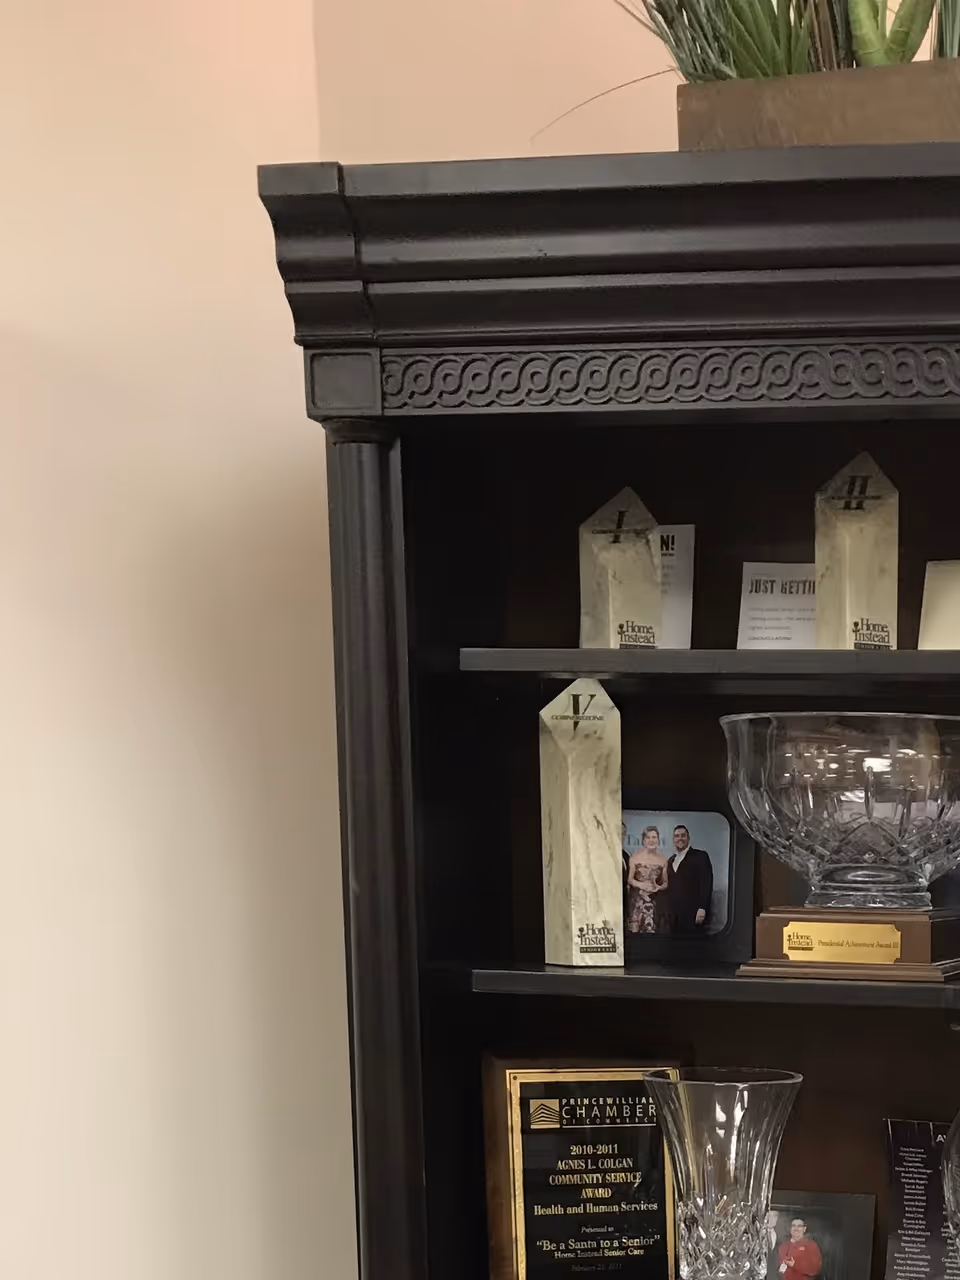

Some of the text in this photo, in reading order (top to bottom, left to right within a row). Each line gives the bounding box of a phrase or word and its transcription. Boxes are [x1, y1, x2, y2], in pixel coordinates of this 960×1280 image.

[839, 475, 873, 510] II
[749, 578, 776, 594] JUST
[626, 621, 653, 634] Home
[861, 618, 888, 632] Home
[619, 632, 655, 644] Instead
[854, 630, 890, 643] Instead
[571, 694, 597, 732] V
[586, 923, 614, 935] Home
[580, 934, 616, 945] Instead
[562, 1105, 657, 1118] CHAMBER
[570, 1143, 619, 1155] 2010-2011
[556, 1157, 634, 1171] AGNES L. COLGAN
[549, 1171, 643, 1185] COMMUNITY SERVICE
[580, 1187, 612, 1199] AWARD
[534, 1200, 659, 1216] Health and Human Services
[559, 1242, 566, 1250] a
[568, 1239, 597, 1250] Santa
[600, 1240, 611, 1248] to
[554, 1251, 576, 1259] Home
[604, 1248, 627, 1257] Senior
[627, 1247, 645, 1255] Care
